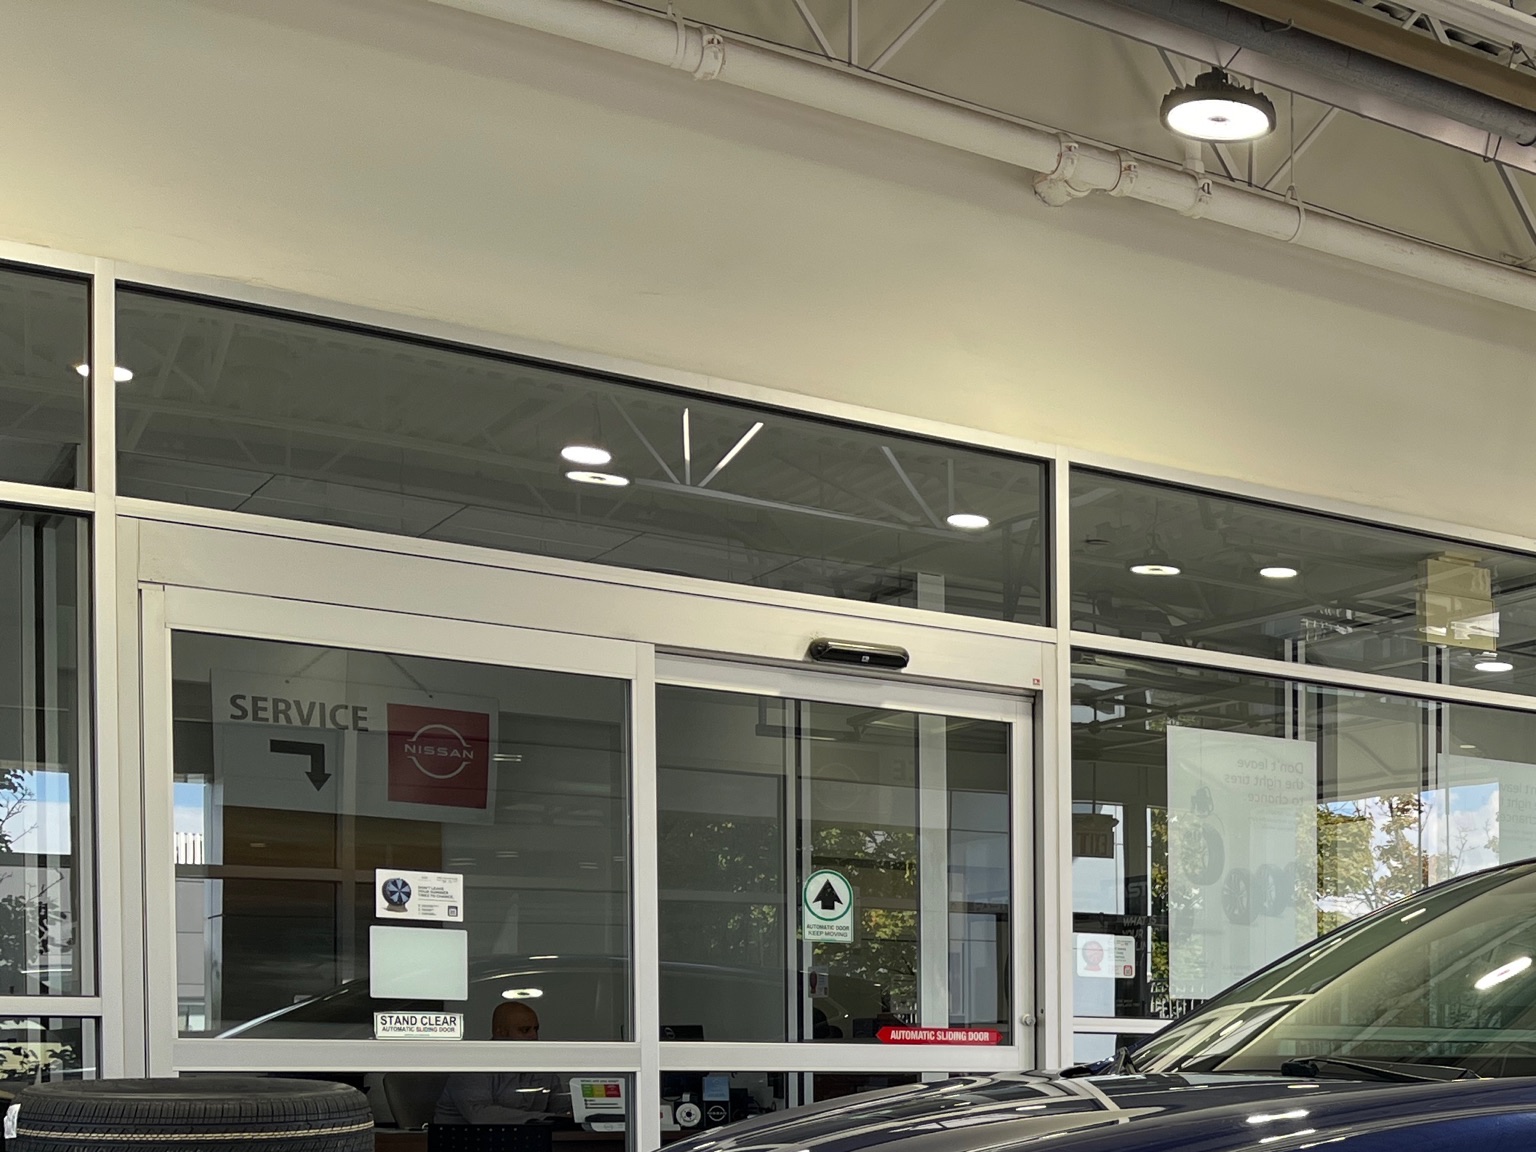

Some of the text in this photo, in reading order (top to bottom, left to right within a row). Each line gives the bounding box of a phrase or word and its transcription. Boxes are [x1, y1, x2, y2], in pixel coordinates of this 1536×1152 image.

[229, 693, 369, 732] SERVICE
[404, 743, 474, 760] NISSAN
[825, 930, 848, 938] MOVING
[380, 1015, 457, 1027] STAND CLEAR
[890, 1029, 990, 1042] AUTOMATIC SLIDING DOOR
